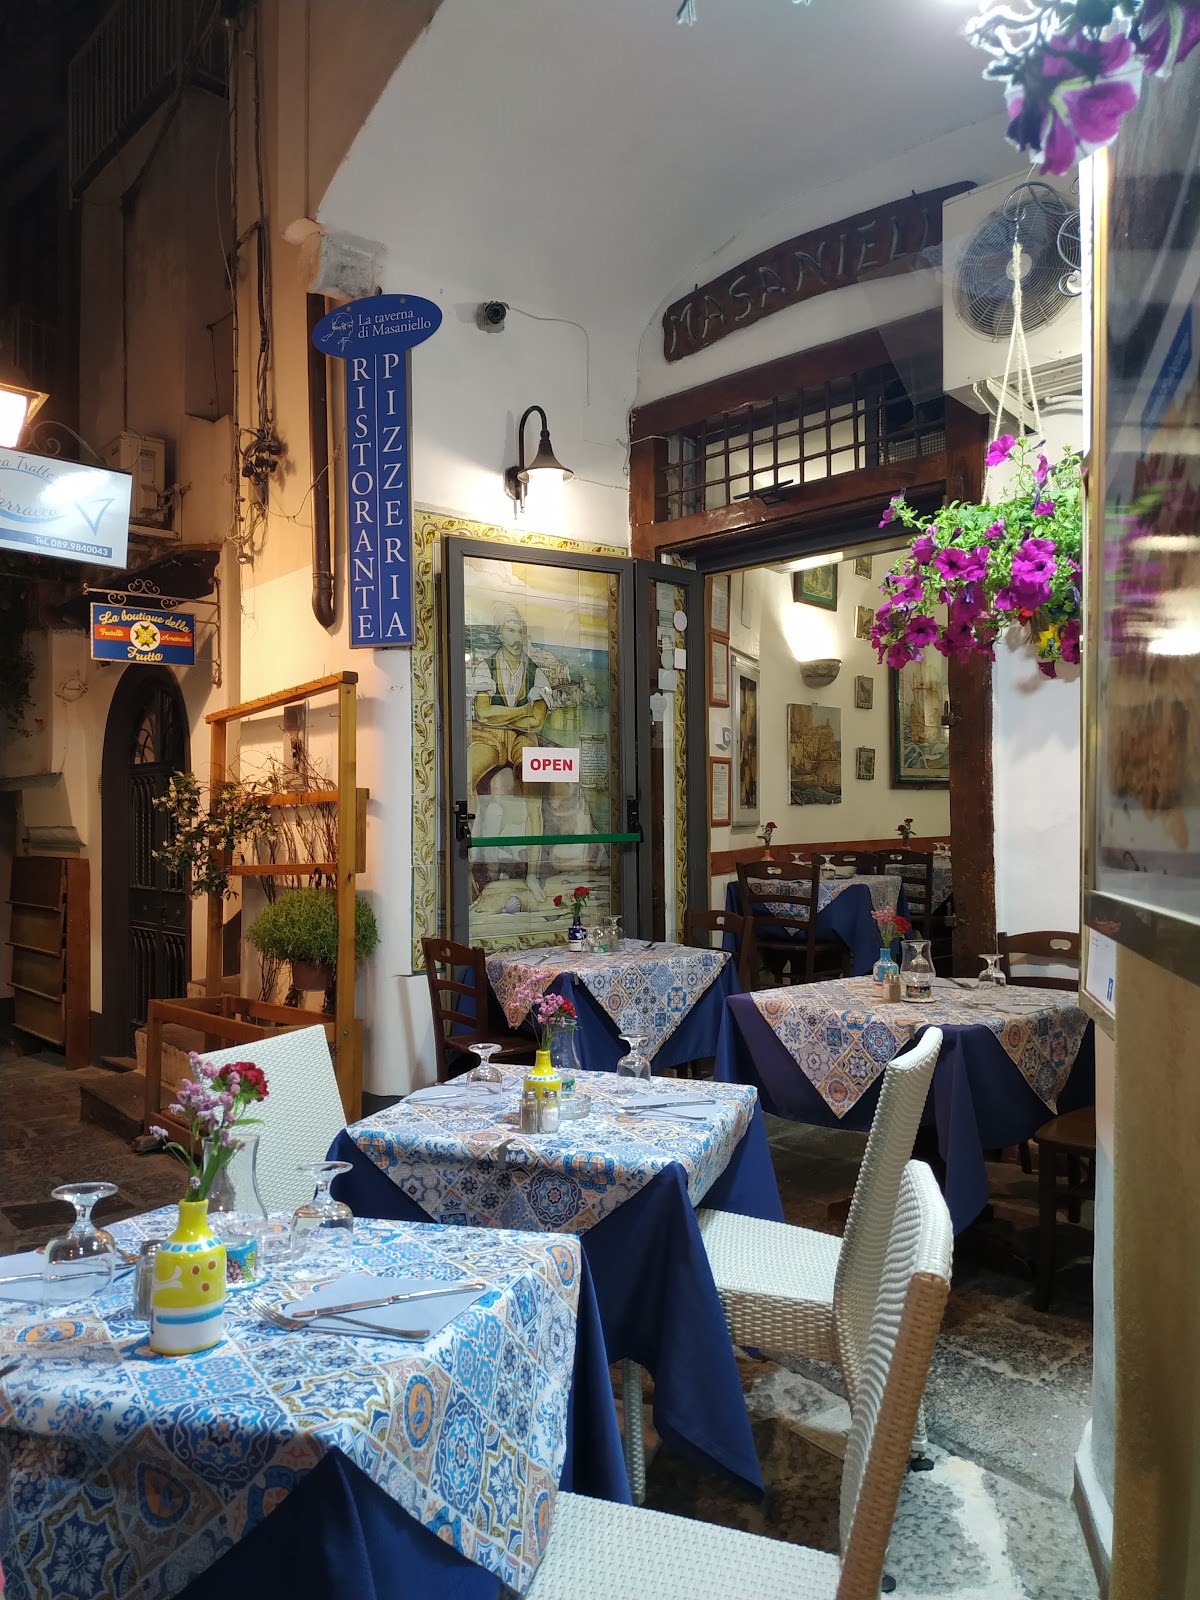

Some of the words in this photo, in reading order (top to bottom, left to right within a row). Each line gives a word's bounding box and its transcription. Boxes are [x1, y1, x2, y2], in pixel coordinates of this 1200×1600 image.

[669, 208, 929, 354] MASANIELL
[358, 314, 371, 326] La
[374, 309, 414, 324] taverna
[358, 326, 369, 338] di
[372, 317, 431, 337] Masaniello
[351, 357, 375, 639] RISTORANTE
[382, 353, 407, 638] PIZZERIA
[35, 536, 49, 546] Tel.
[51, 537, 109, 556] 089.9840043
[99, 611, 120, 625] La
[121, 609, 165, 624] boutique
[165, 616, 191, 633] della
[127, 646, 163, 661] Frutta
[530, 758, 573, 771] OPEN
